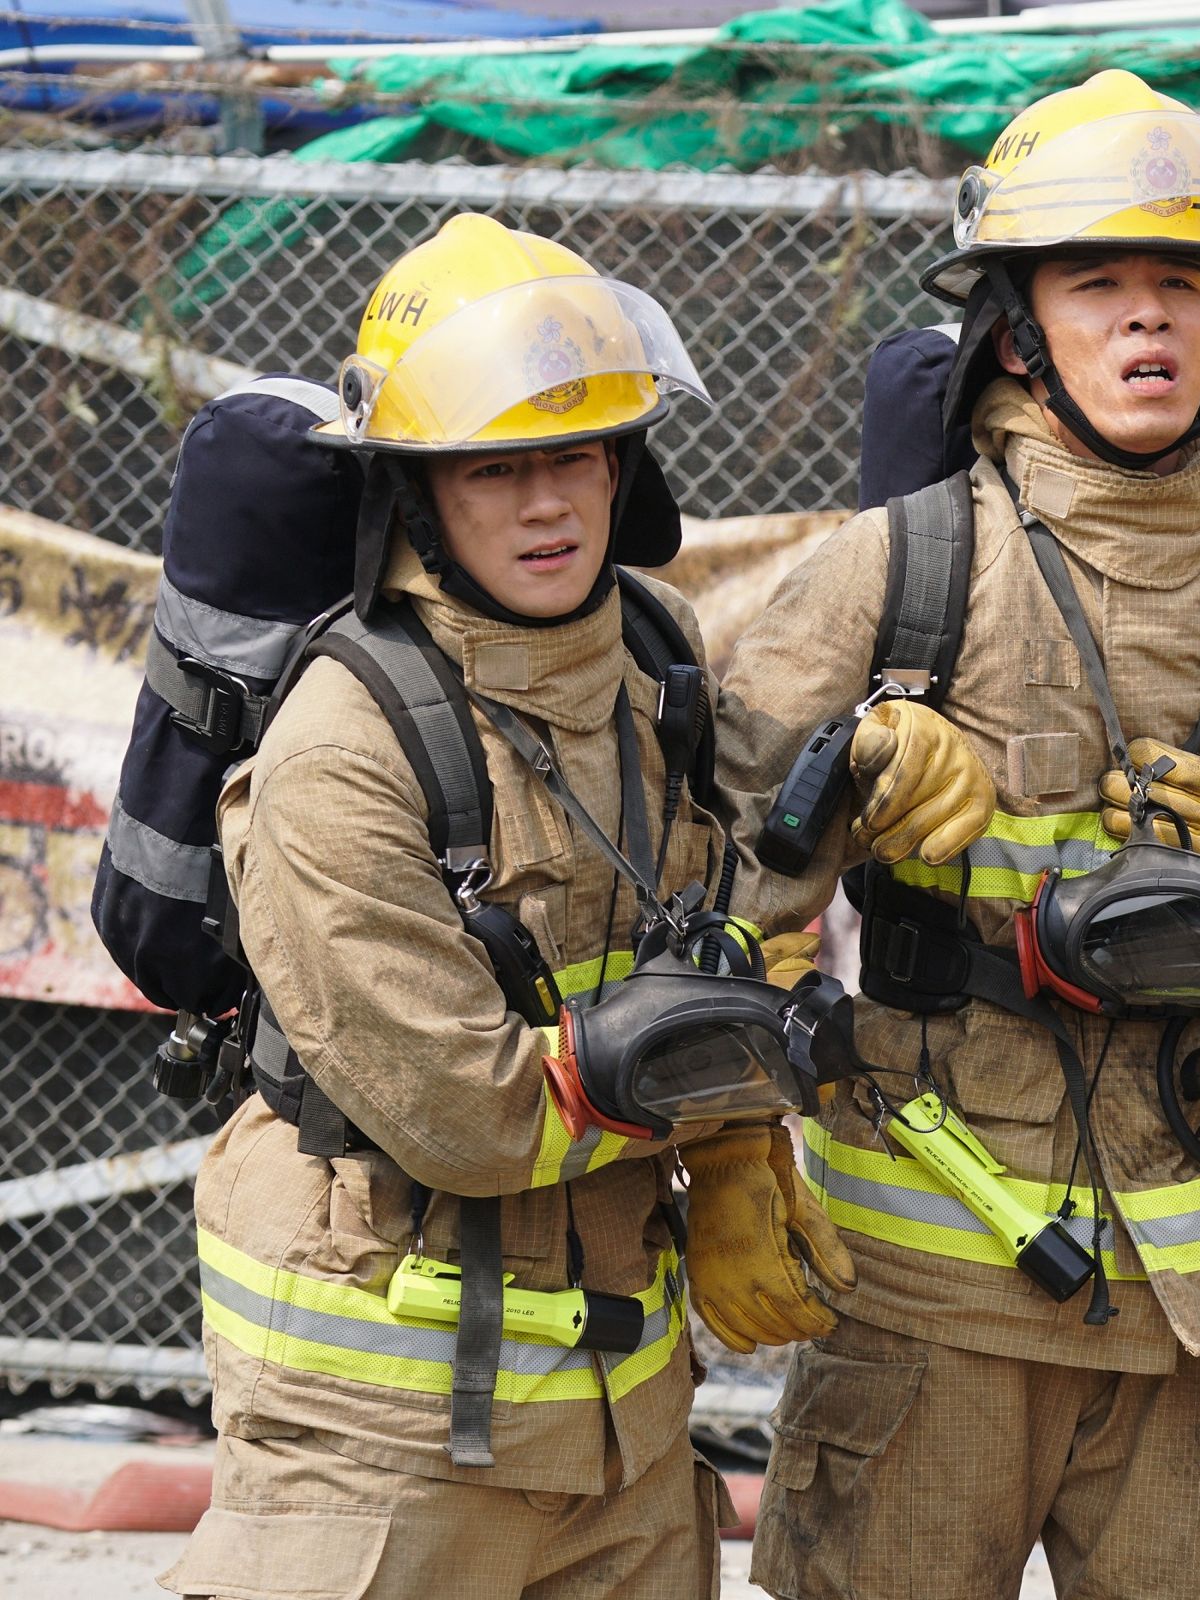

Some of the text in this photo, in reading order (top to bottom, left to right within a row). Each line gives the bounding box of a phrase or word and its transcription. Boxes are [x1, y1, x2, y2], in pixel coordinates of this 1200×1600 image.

[985, 131, 1040, 169] WH
[1141, 202, 1186, 215] HONG KONG
[367, 292, 428, 326] LWH
[536, 396, 583, 412] HONG KONG
[443, 1298, 461, 1306] PELIC
